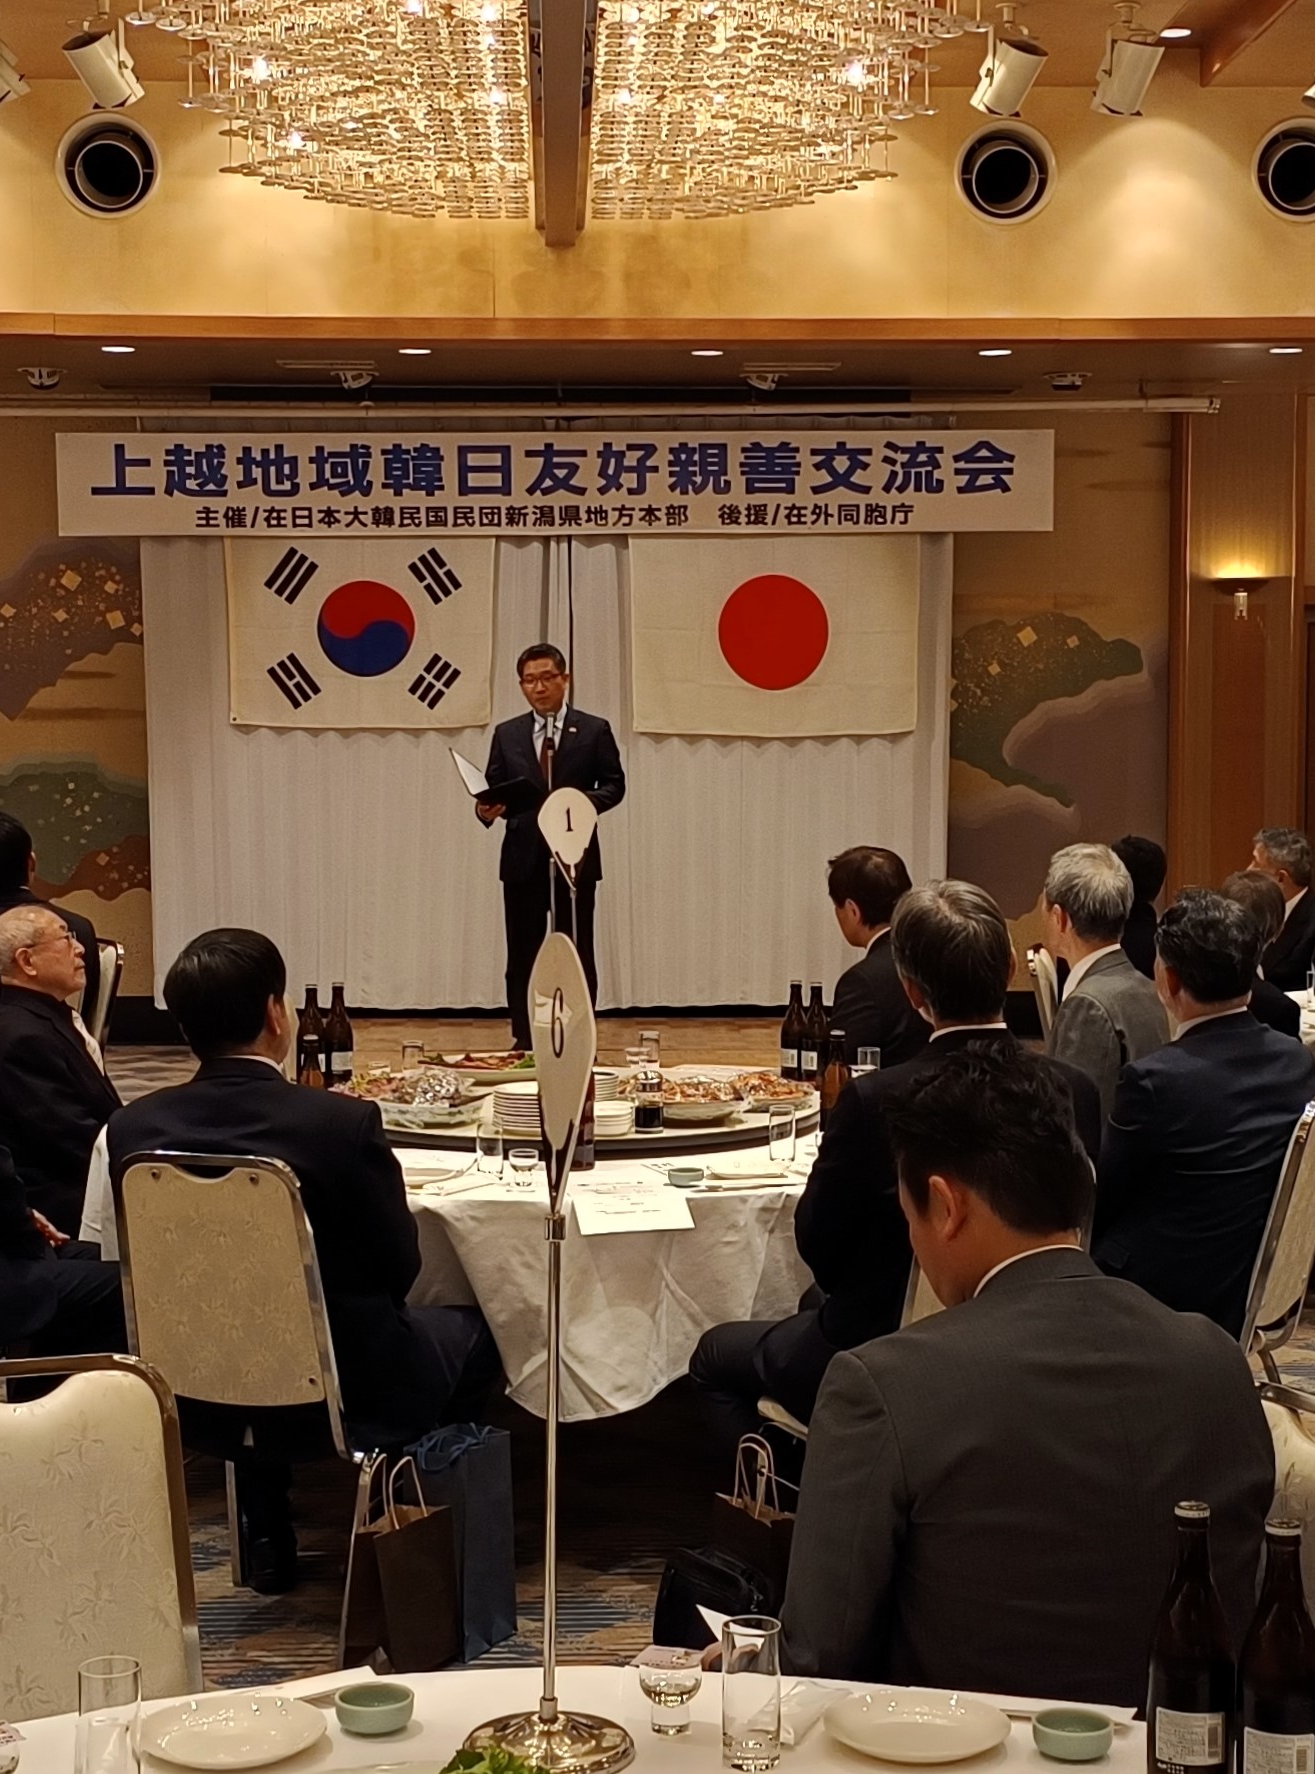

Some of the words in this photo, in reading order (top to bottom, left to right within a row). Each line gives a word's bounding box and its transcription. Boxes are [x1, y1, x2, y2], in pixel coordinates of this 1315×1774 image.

[90, 441, 1017, 498] 上越地域韓日友好親善交流会
[195, 504, 690, 529] 主催/在日本大韓民国民団新潟県地方本部
[717, 502, 916, 526] 後援/在外同胞庁
[565, 807, 574, 832] 1
[551, 987, 564, 1058] 6
